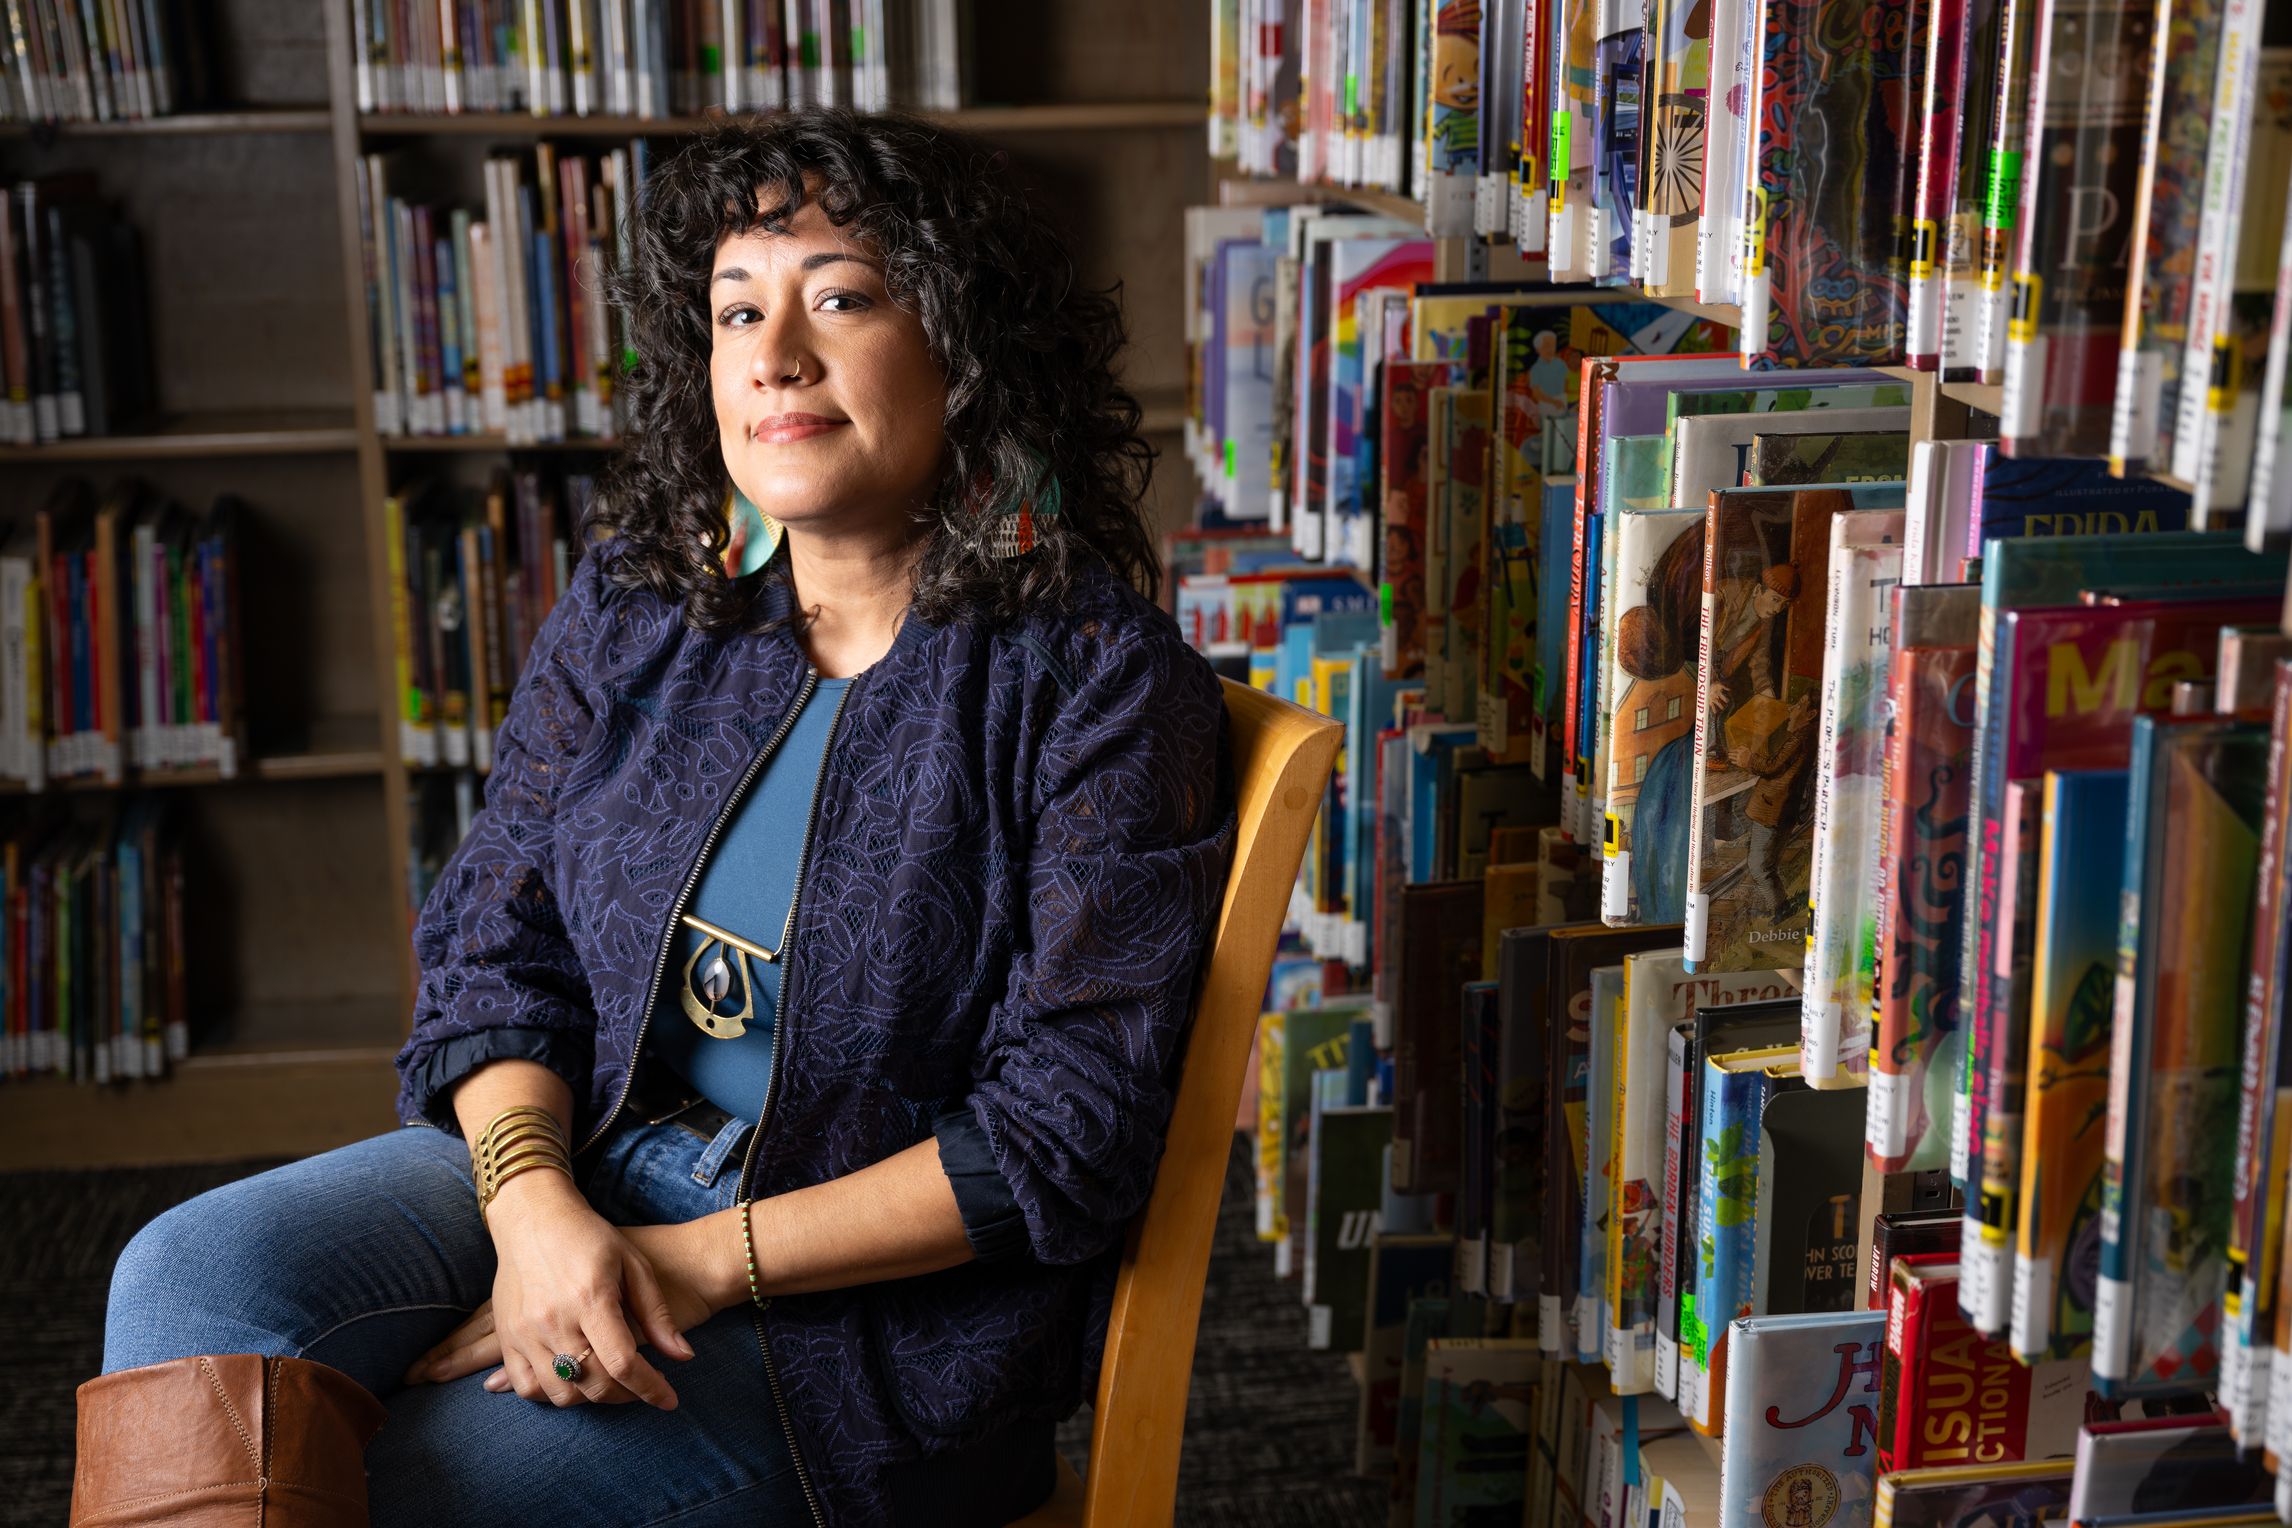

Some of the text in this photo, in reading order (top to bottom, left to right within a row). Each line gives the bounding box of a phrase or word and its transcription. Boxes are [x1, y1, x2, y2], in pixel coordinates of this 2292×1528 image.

[1704, 504, 1715, 583] Levy Kulikov
[2024, 510, 2161, 537] FRIDA
[1694, 606, 1710, 758] THE FRIENDSHIP TRAIN
[1749, 930, 1799, 944] Debbie
[1708, 1090, 1716, 1125] Hinton
[1661, 1111, 1680, 1299] THE BORDEN MURDERS
[1703, 1164, 1714, 1246] THE SUN
[1805, 1264, 1833, 1281] VER
[1831, 1246, 1858, 1261] SCO
[1870, 1244, 1881, 1292] JARROW
[1889, 1289, 1906, 1356] MARVEL
[1922, 1320, 1977, 1462] ISUAL
[1975, 1344, 2012, 1463] CTIONA
